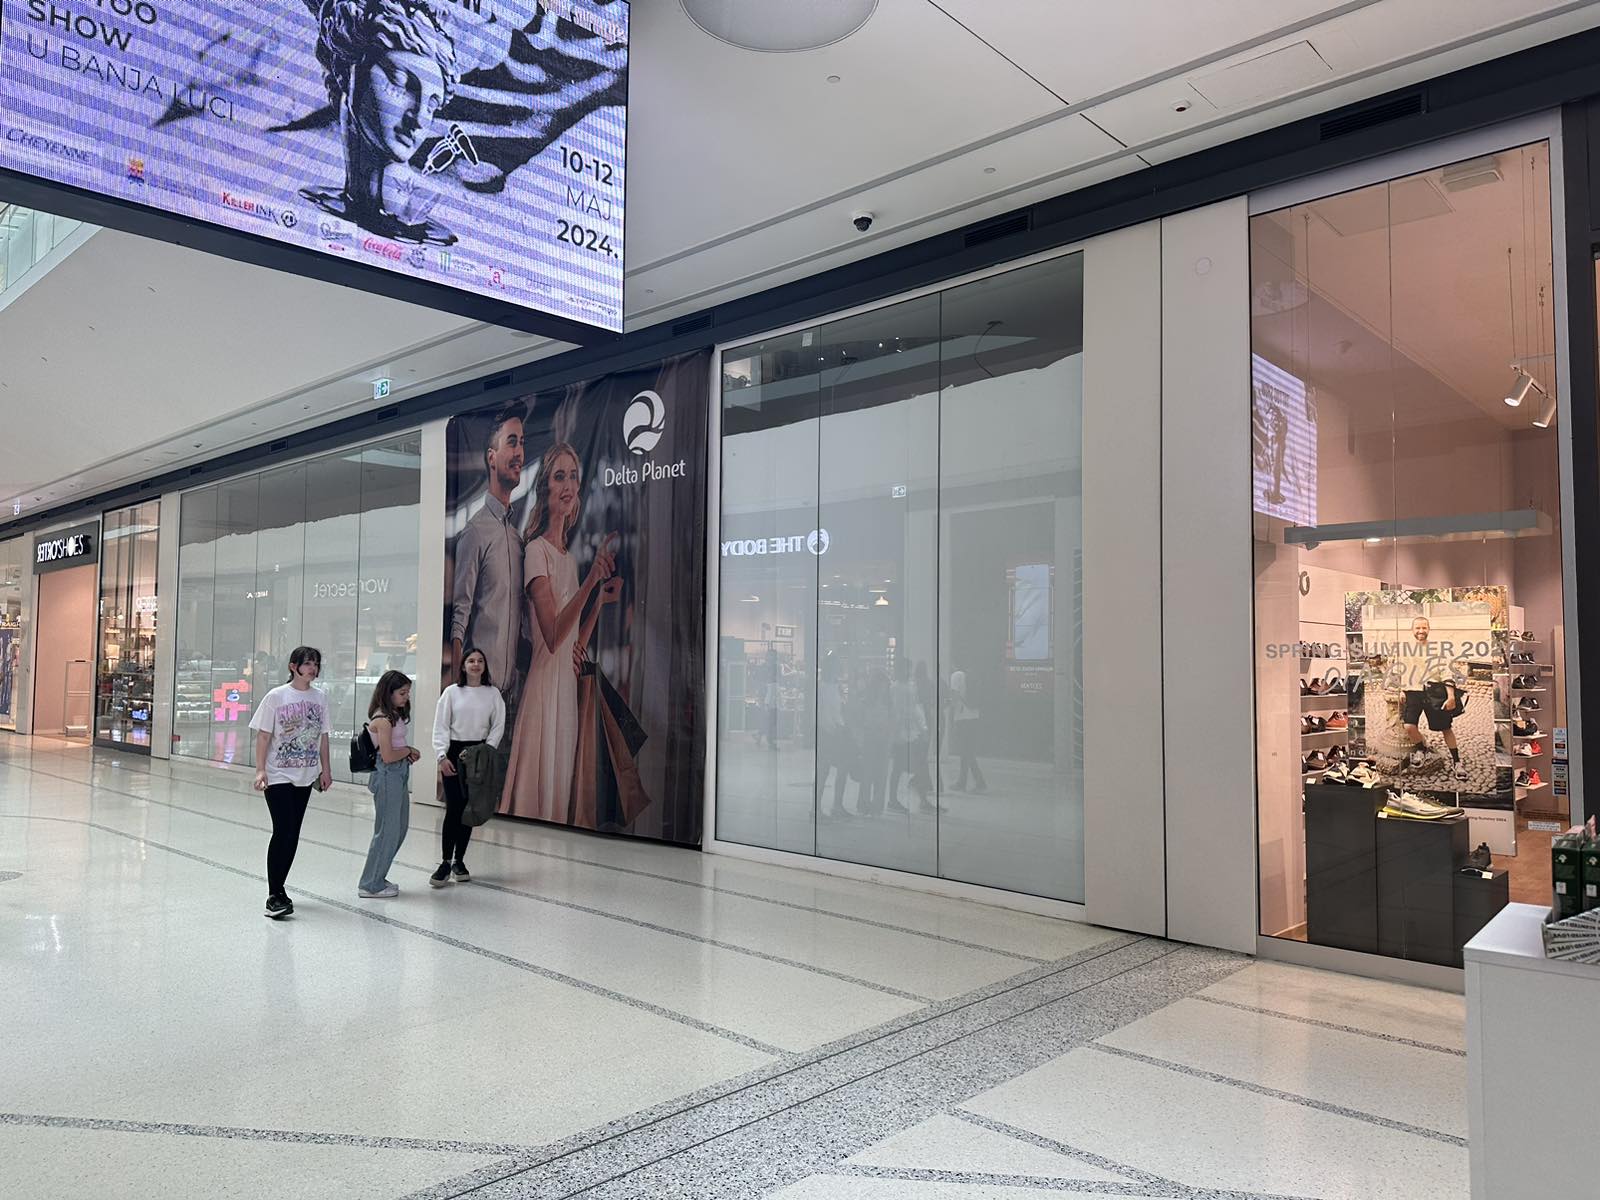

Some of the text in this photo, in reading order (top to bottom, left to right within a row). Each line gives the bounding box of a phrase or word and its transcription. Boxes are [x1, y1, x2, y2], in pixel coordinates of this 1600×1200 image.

[28, 0, 132, 51] SHOW
[28, 34, 48, 60] U
[61, 45, 163, 99] BANJA
[560, 146, 613, 186] 10-12
[566, 185, 611, 221] MAJ
[556, 219, 618, 259] 2024.
[604, 459, 686, 487] Delta Planet
